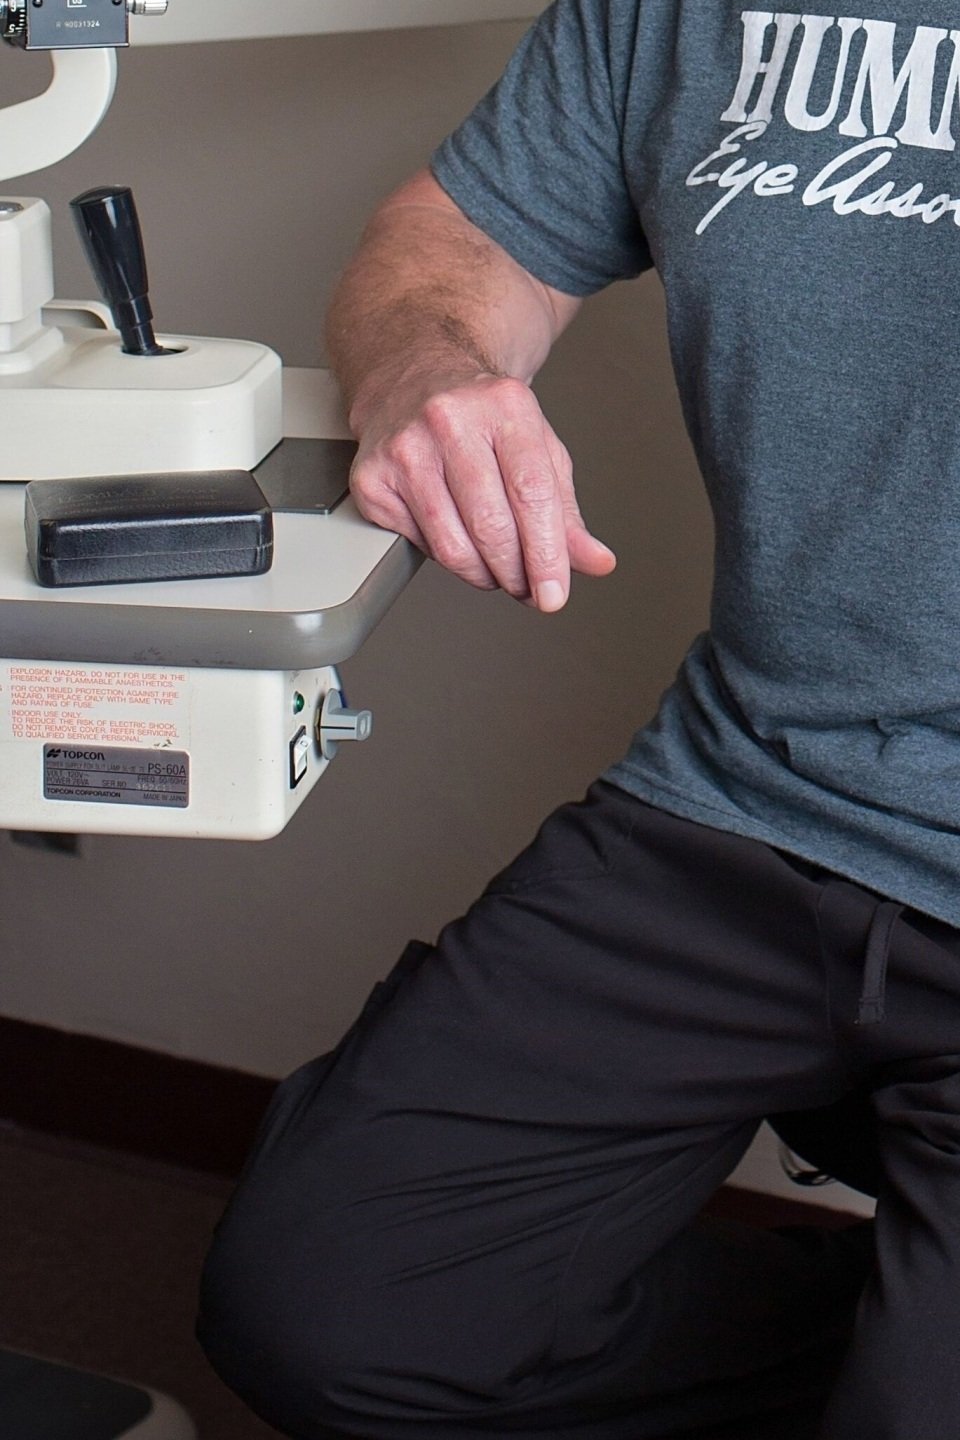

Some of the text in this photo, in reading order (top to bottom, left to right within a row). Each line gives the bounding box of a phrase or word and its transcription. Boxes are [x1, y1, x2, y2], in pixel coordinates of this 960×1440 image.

[686, 120, 799, 235] Eye
[10, 667, 52, 675] EXPLOSION
[66, 677, 112, 685] FLAMMABLE
[29, 686, 73, 694] CONTINUED
[76, 688, 124, 696] PROTECTION
[127, 690, 159, 698] AGAINST
[110, 720, 146, 728] ELECTRIC
[26, 731, 65, 739] QUALIFIED
[62, 750, 105, 760] TOPCON
[148, 763, 186, 775] PS-60A
[47, 787, 121, 797] TOPCON CORPORATION
